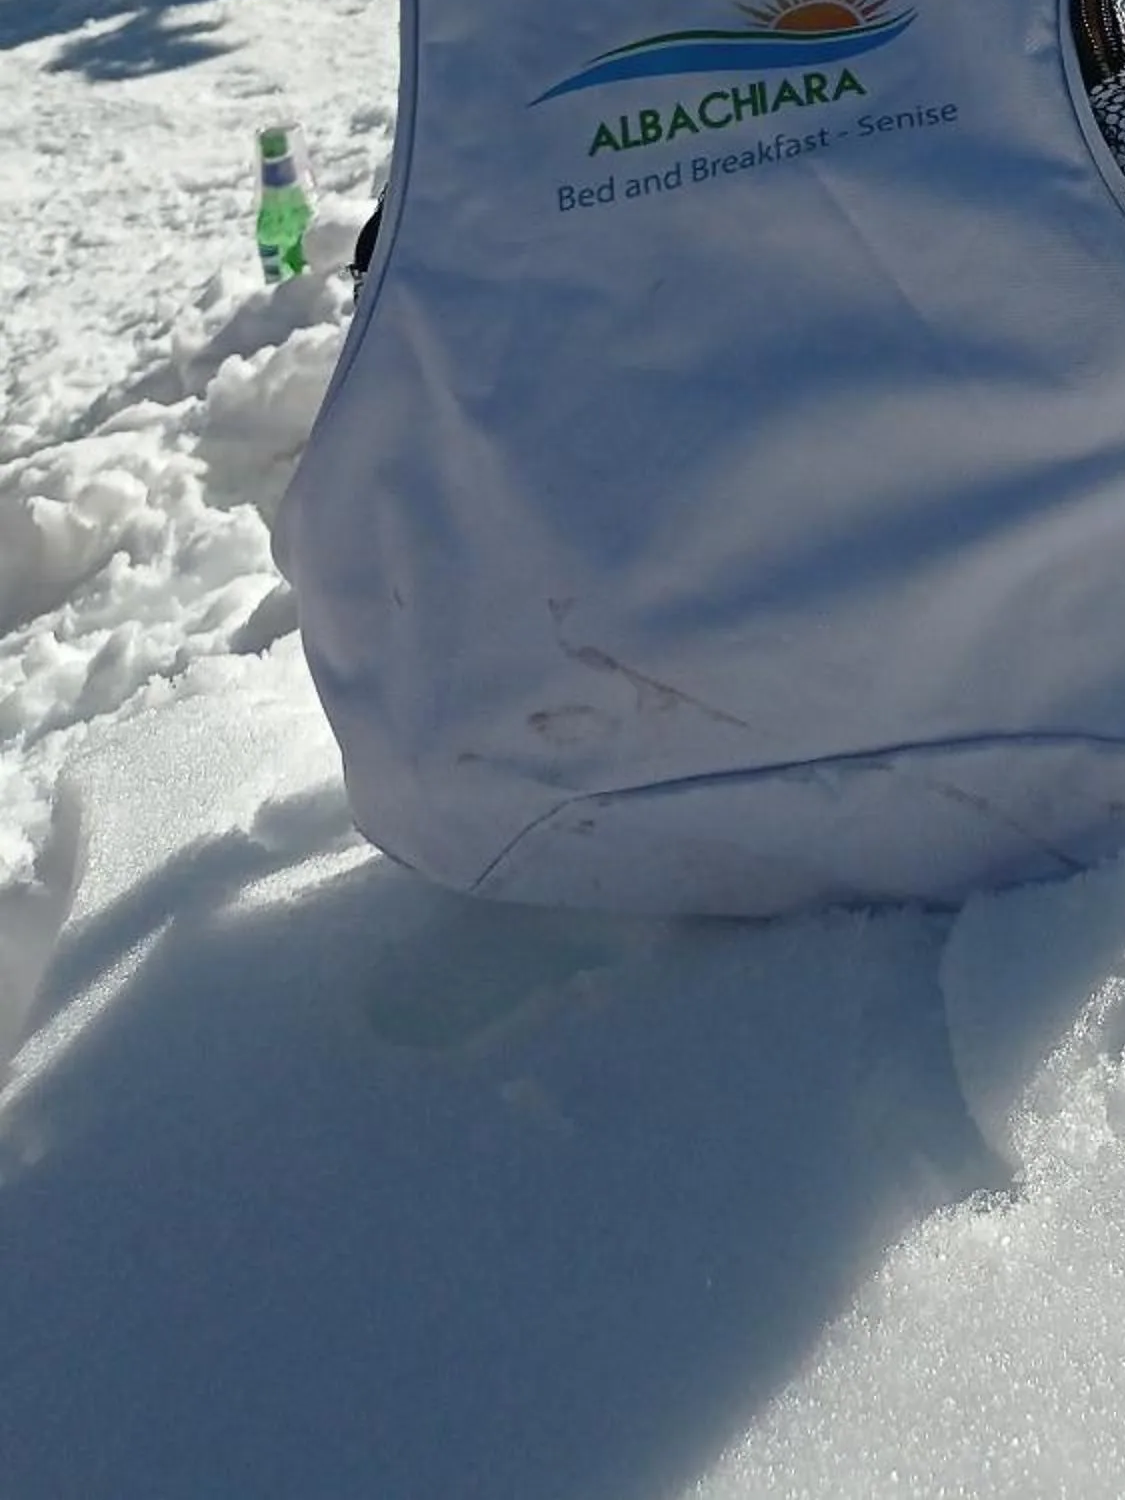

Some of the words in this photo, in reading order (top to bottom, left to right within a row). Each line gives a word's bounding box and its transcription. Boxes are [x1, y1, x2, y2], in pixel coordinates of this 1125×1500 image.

[557, 175, 615, 211] Bed
[625, 163, 682, 198] and
[692, 126, 831, 182] Breakfast
[858, 103, 958, 138] Senise
[588, 68, 867, 156] ALBACHIARA
